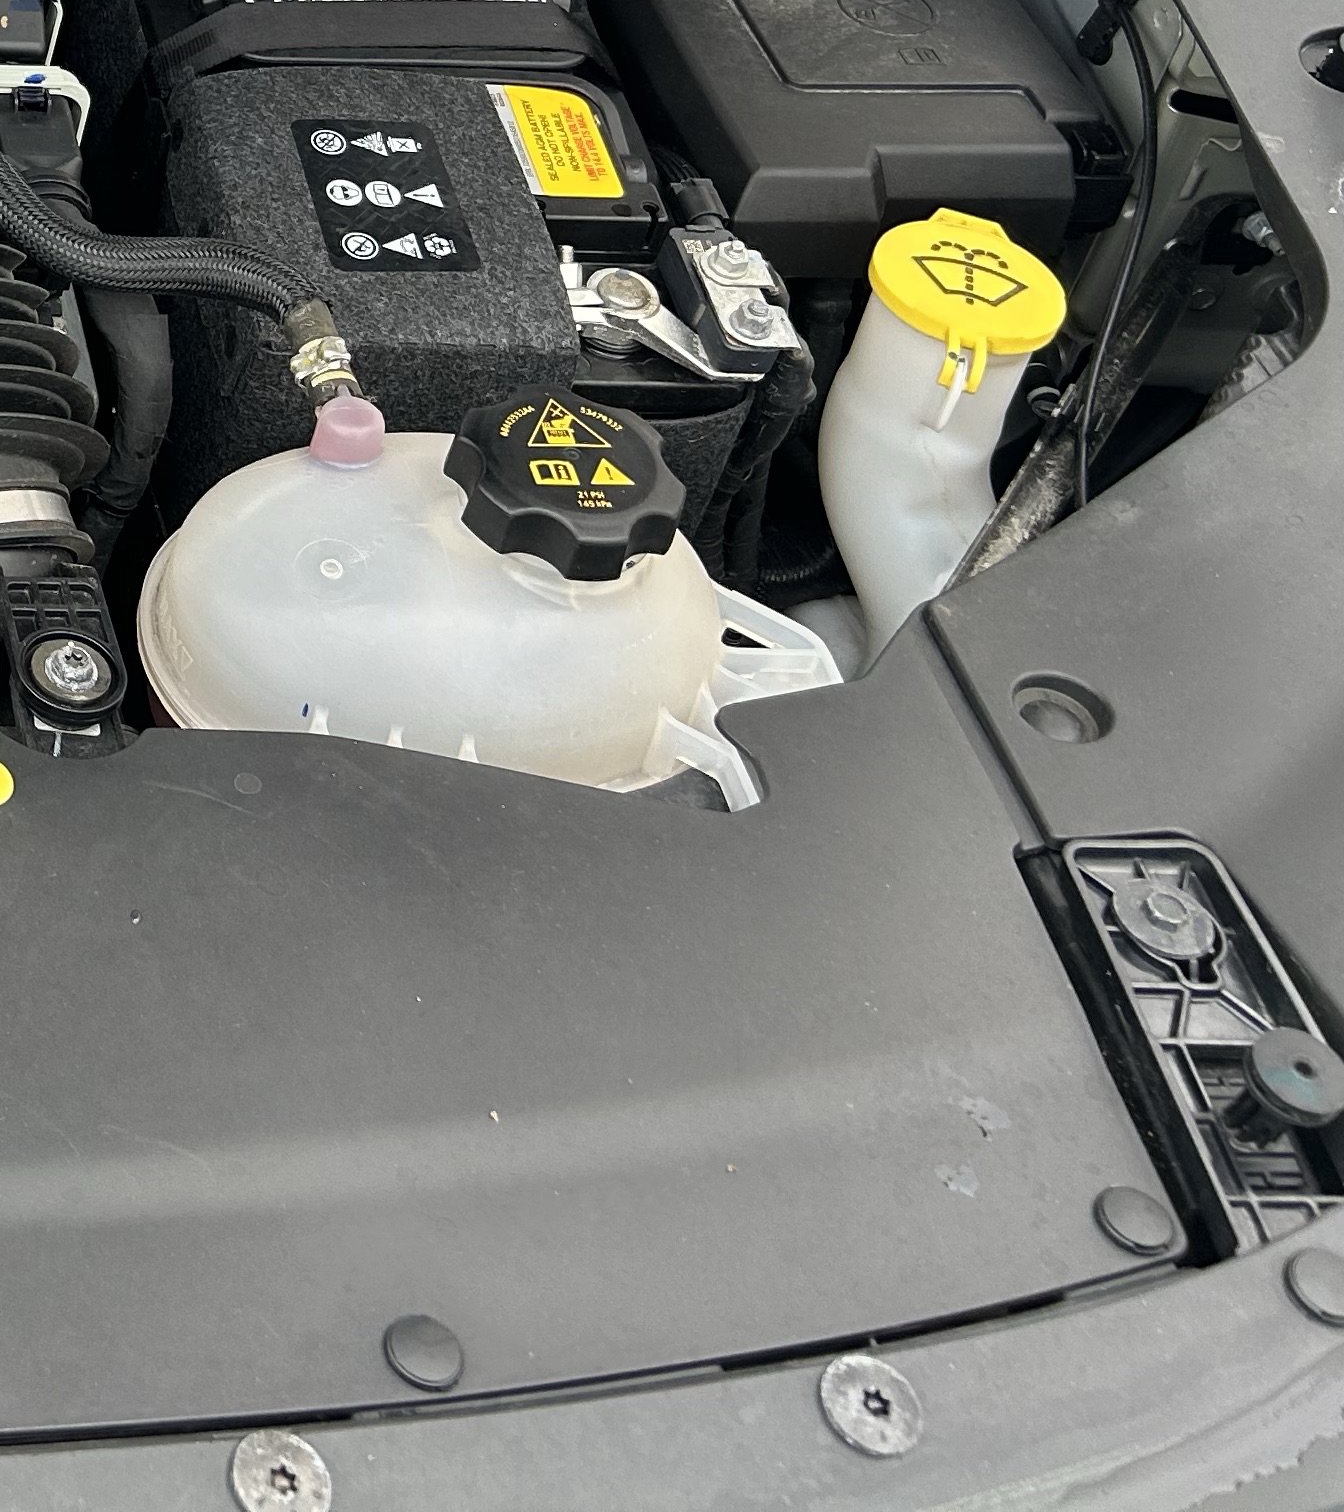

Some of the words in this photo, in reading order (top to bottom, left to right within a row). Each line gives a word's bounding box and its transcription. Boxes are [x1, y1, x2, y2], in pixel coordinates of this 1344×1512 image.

[520, 100, 541, 133] BATTERY
[536, 134, 547, 152] AGM
[547, 139, 559, 154] NOT
[551, 112, 581, 172] NON-SPILLABLE
[541, 152, 560, 182] SEALED
